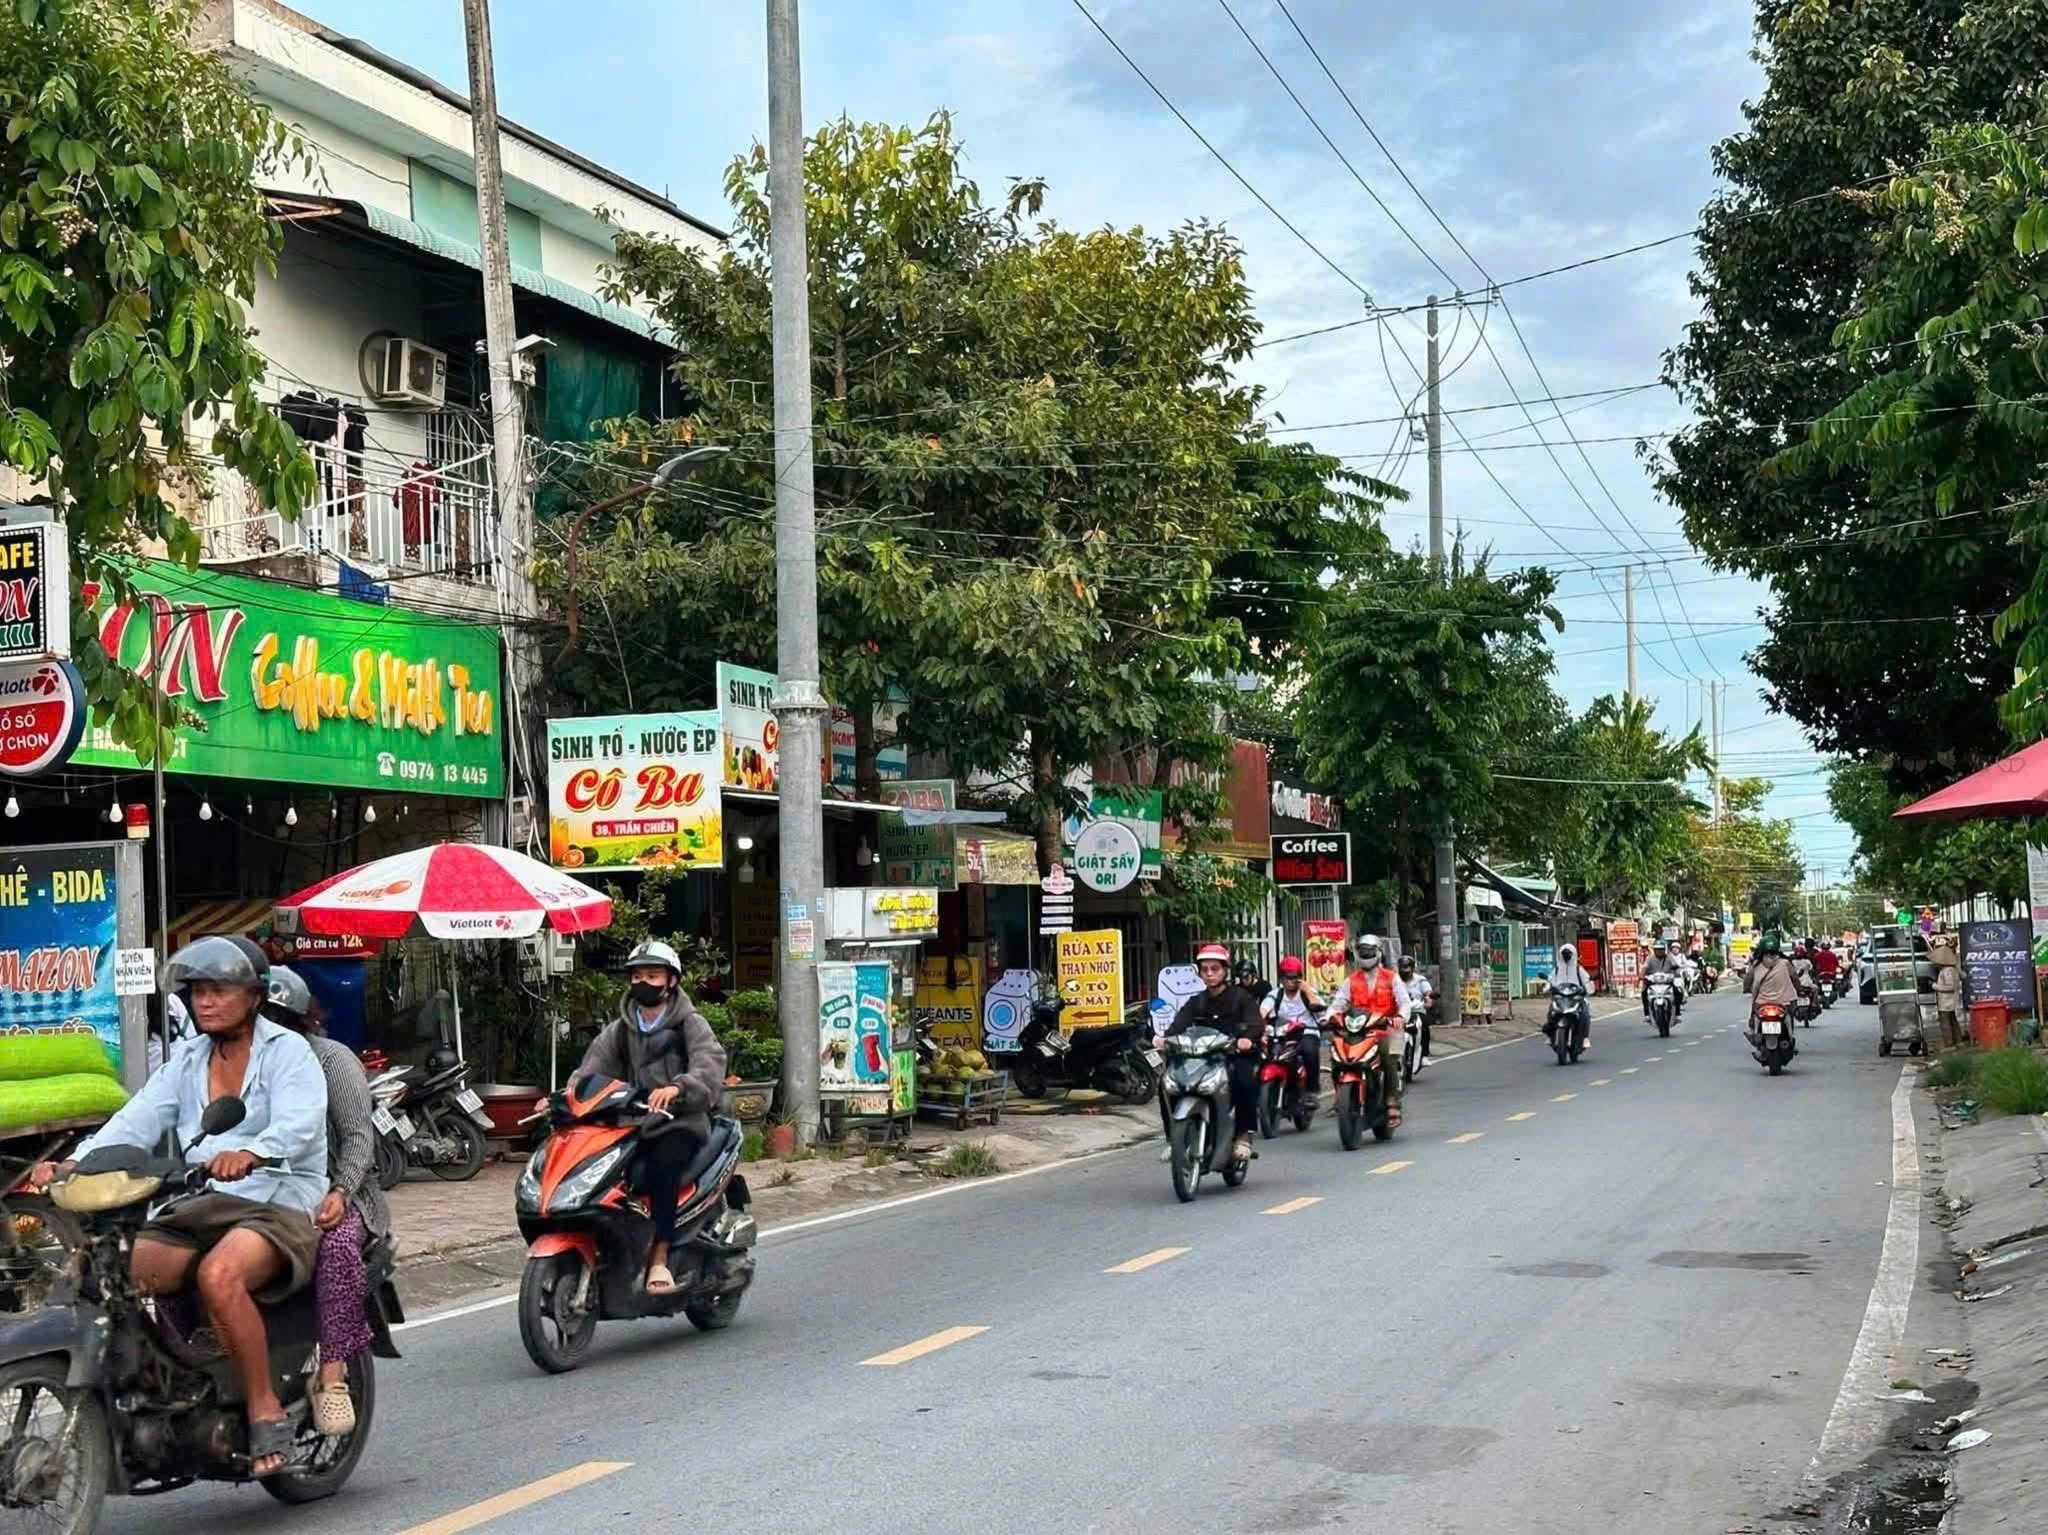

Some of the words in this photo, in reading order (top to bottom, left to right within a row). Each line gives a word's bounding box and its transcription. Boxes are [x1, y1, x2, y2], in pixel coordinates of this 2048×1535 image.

[730, 679, 756, 704] SINH
[15, 708, 36, 729] SỐ
[7, 732, 49, 752] CHỌN
[551, 734, 593, 761] SINH
[599, 725, 623, 758] TỐ
[640, 725, 688, 756] NƯỚC
[693, 723, 717, 753] ÉP
[400, 760, 434, 780] 0974
[462, 766, 488, 785] 445
[565, 767, 627, 813] Cô
[634, 764, 705, 813] Ba
[1281, 839, 1338, 853] Coffee
[1078, 855, 1106, 875] GIẶT
[1110, 851, 1135, 869] SẤY
[53, 869, 106, 904] BIDA
[1095, 873, 1117, 886] ORI
[449, 917, 493, 930] Vietlott
[1096, 941, 1114, 955] XE
[2003, 950, 2028, 961] XE
[1061, 961, 1087, 976] THAY
[1085, 994, 1112, 1006] MÁY
